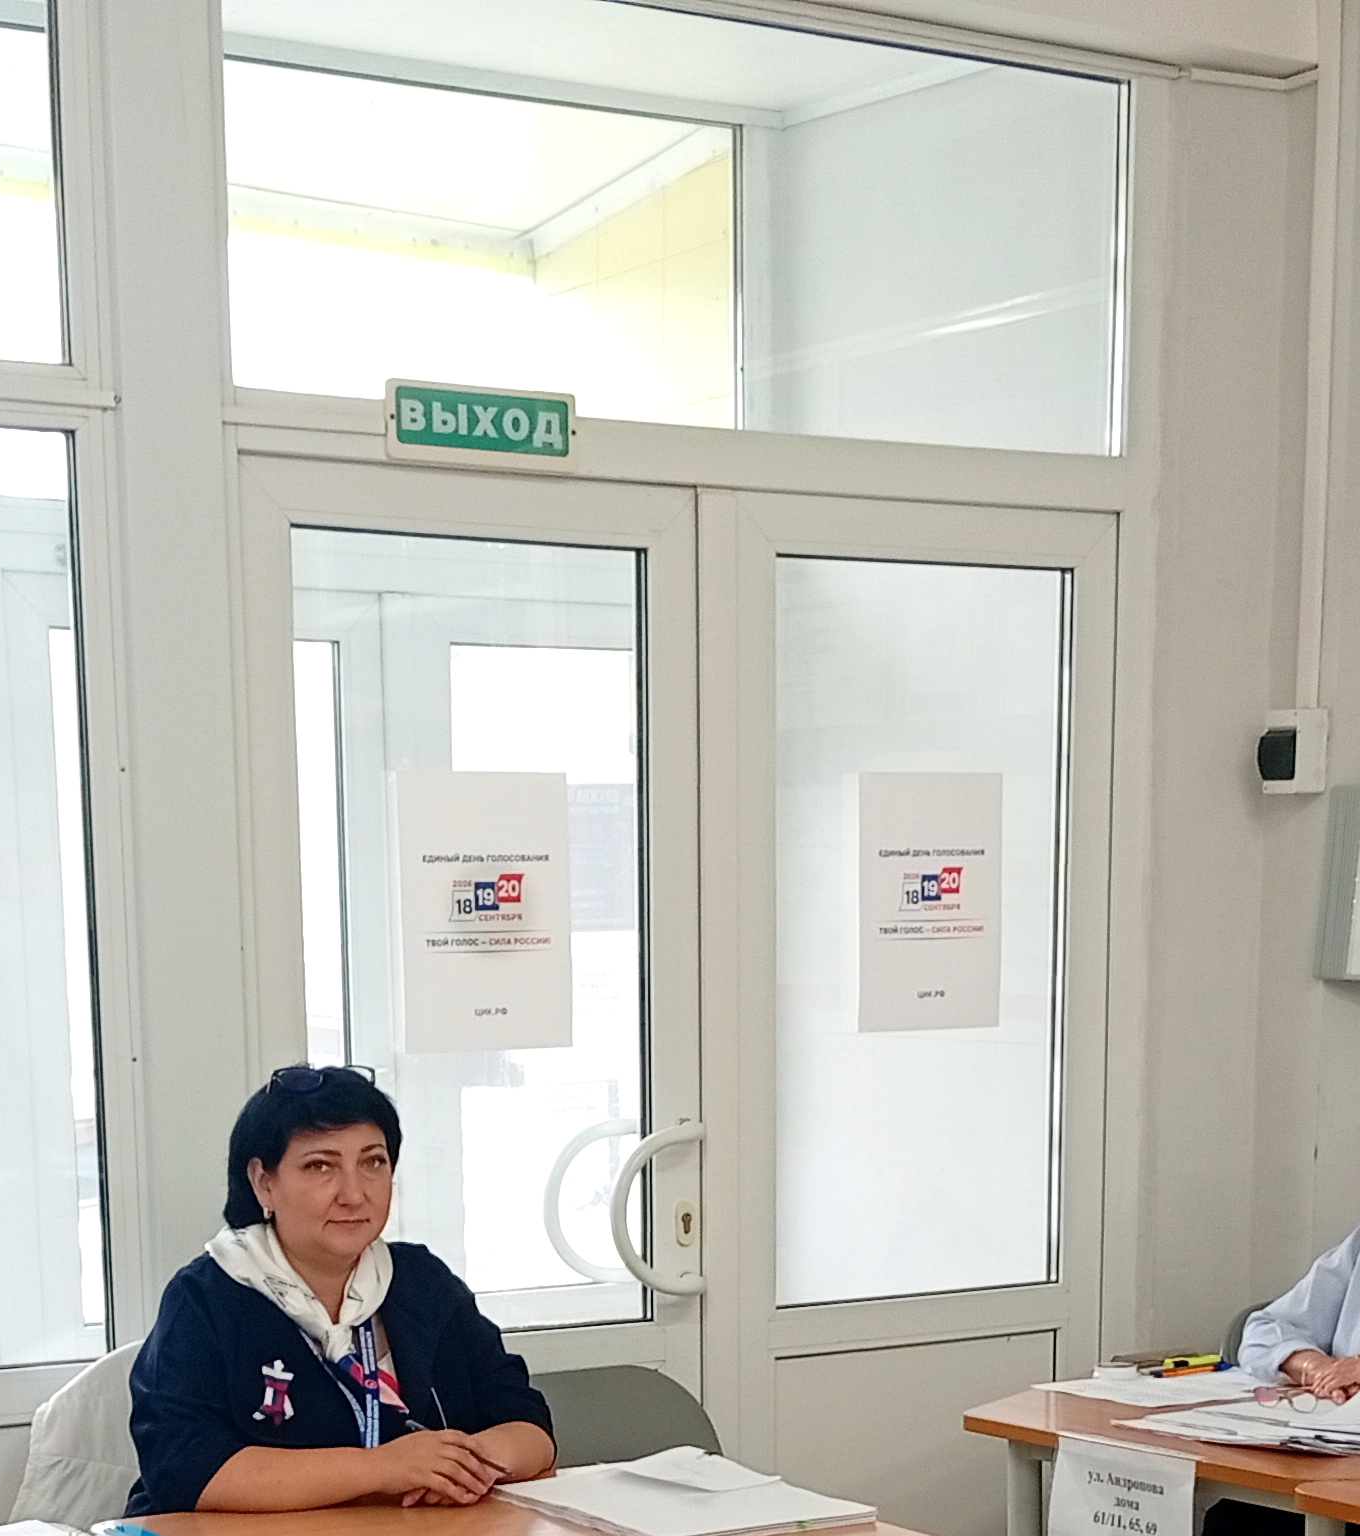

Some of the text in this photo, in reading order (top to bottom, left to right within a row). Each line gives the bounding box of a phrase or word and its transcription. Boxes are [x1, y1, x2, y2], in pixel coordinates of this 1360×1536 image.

[400, 398, 562, 450] ВЫХОД
[422, 853, 549, 863] ЕДИНЫЙ ДЕНЬ ГОЛОСОВАНИЯ
[456, 880, 519, 914] 18 19 20
[905, 873, 958, 904] 18 19 20
[879, 926, 923, 934] ТВОЙ ГОЛОС
[426, 938, 448, 947] ТВОЙ
[1088, 1471, 1164, 1495] ул. Андропова
[1115, 1497, 1139, 1510] дома
[1093, 1511, 1157, 1535] 61/11, 65, 69
